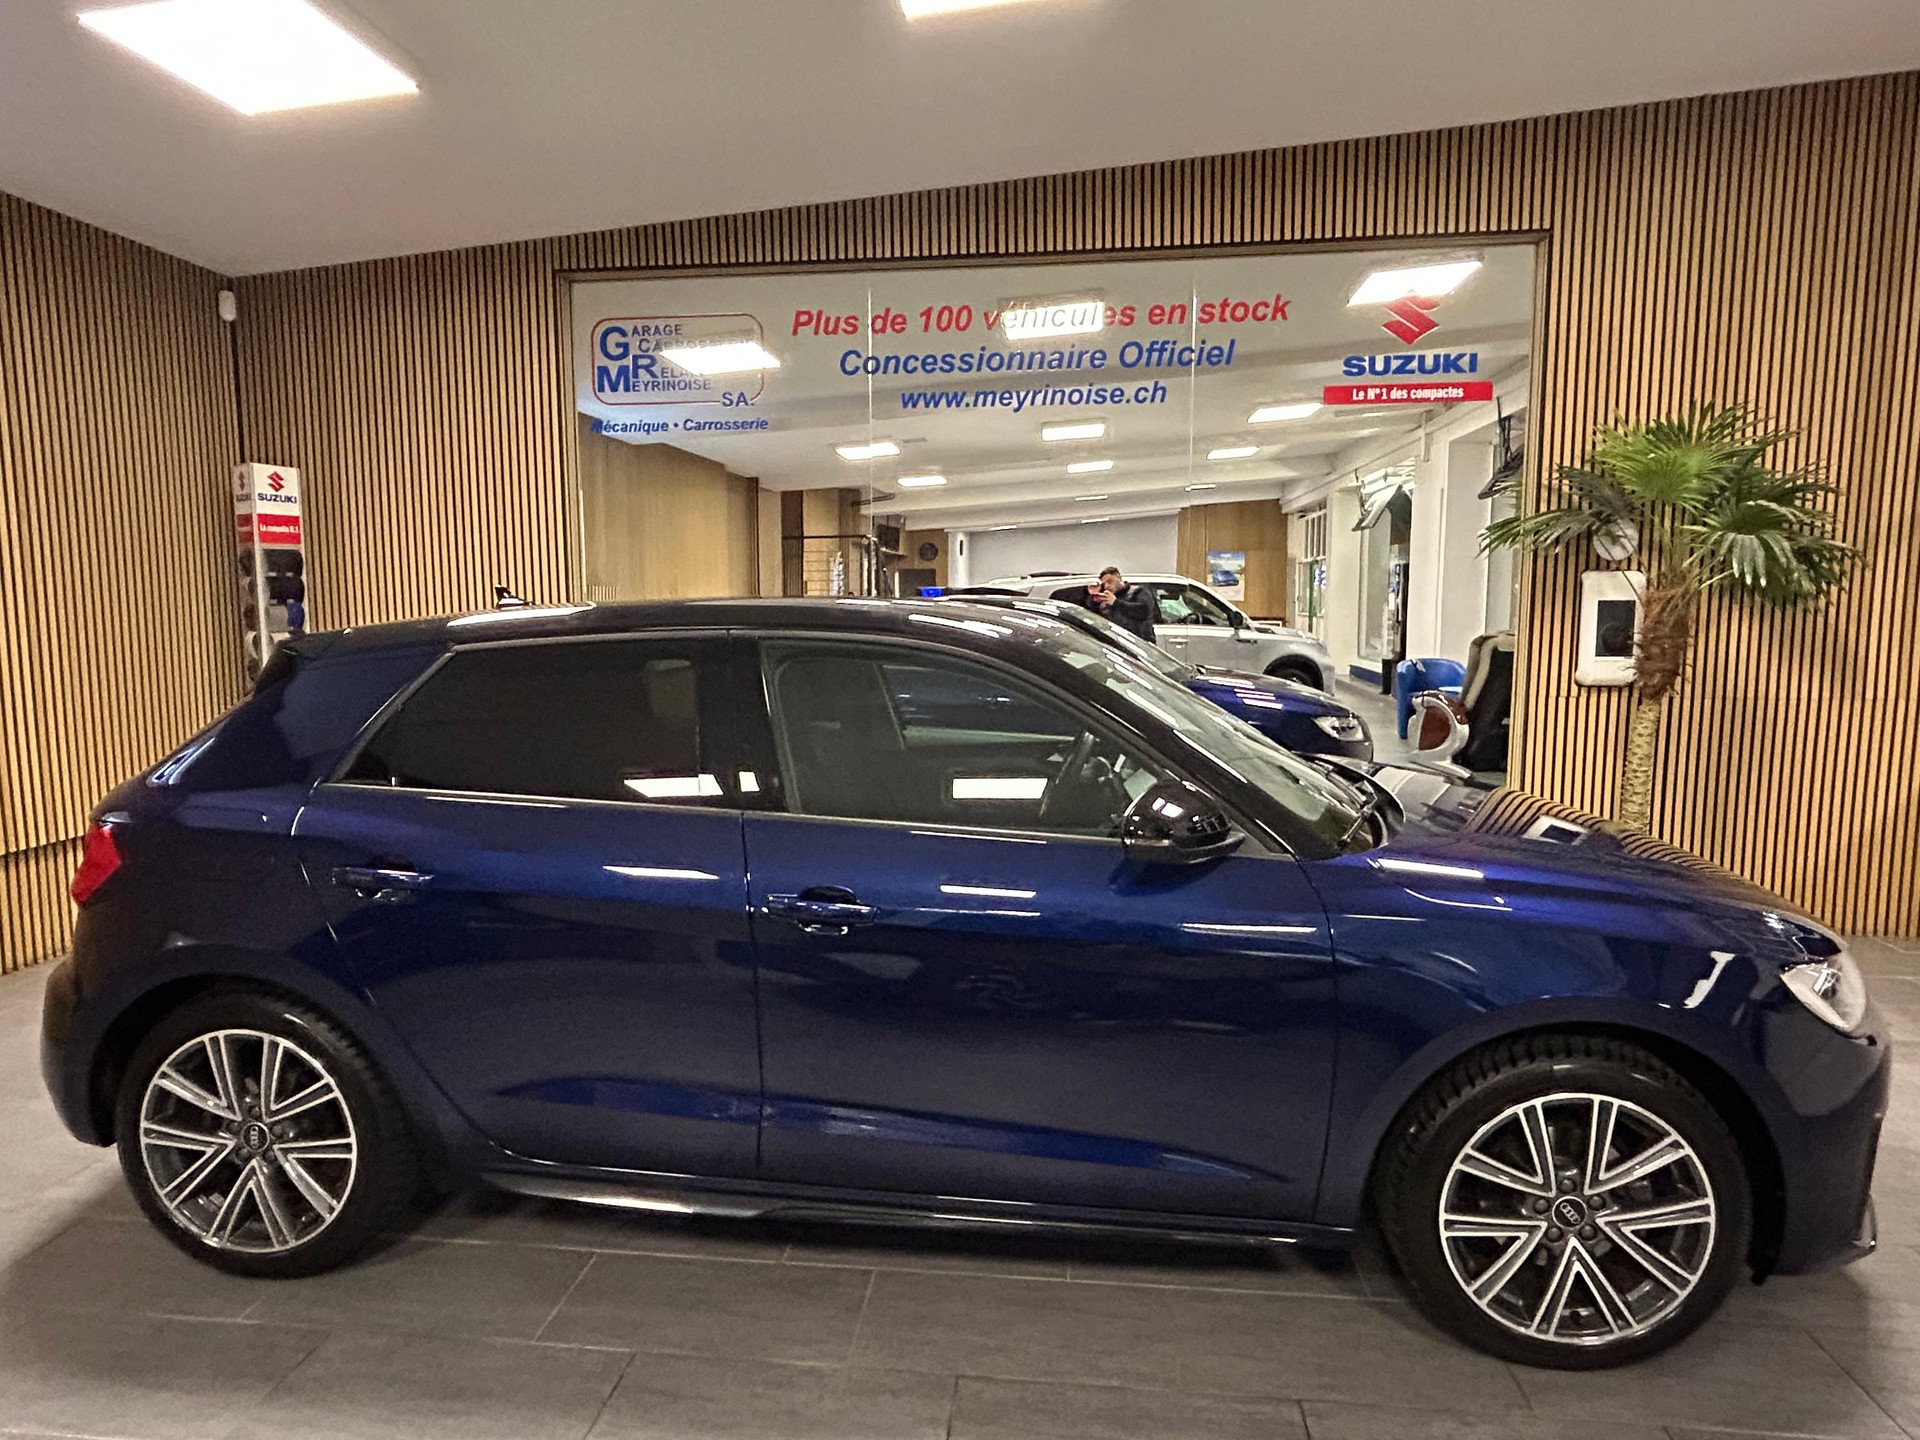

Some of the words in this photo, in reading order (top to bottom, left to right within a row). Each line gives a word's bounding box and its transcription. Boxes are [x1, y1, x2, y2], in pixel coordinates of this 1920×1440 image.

[791, 309, 859, 336] Plus
[872, 307, 907, 334] de
[919, 304, 973, 333] 100
[983, 301, 1136, 331] véhicules
[1148, 302, 1186, 325] en
[1198, 294, 1291, 324] stock
[840, 343, 1107, 376] Concessionnaire
[1119, 338, 1236, 368] Officiel
[1342, 352, 1478, 377] SUZUKI
[901, 380, 1167, 412] www.meyrinoise.ch
[1352, 388, 1365, 400] Le
[1390, 386, 1408, 399] des
[1410, 386, 1464, 400] compactes
[590, 419, 669, 435] Mécanique
[682, 417, 769, 432] Carrosserie
[257, 492, 298, 504] SUZUKI
